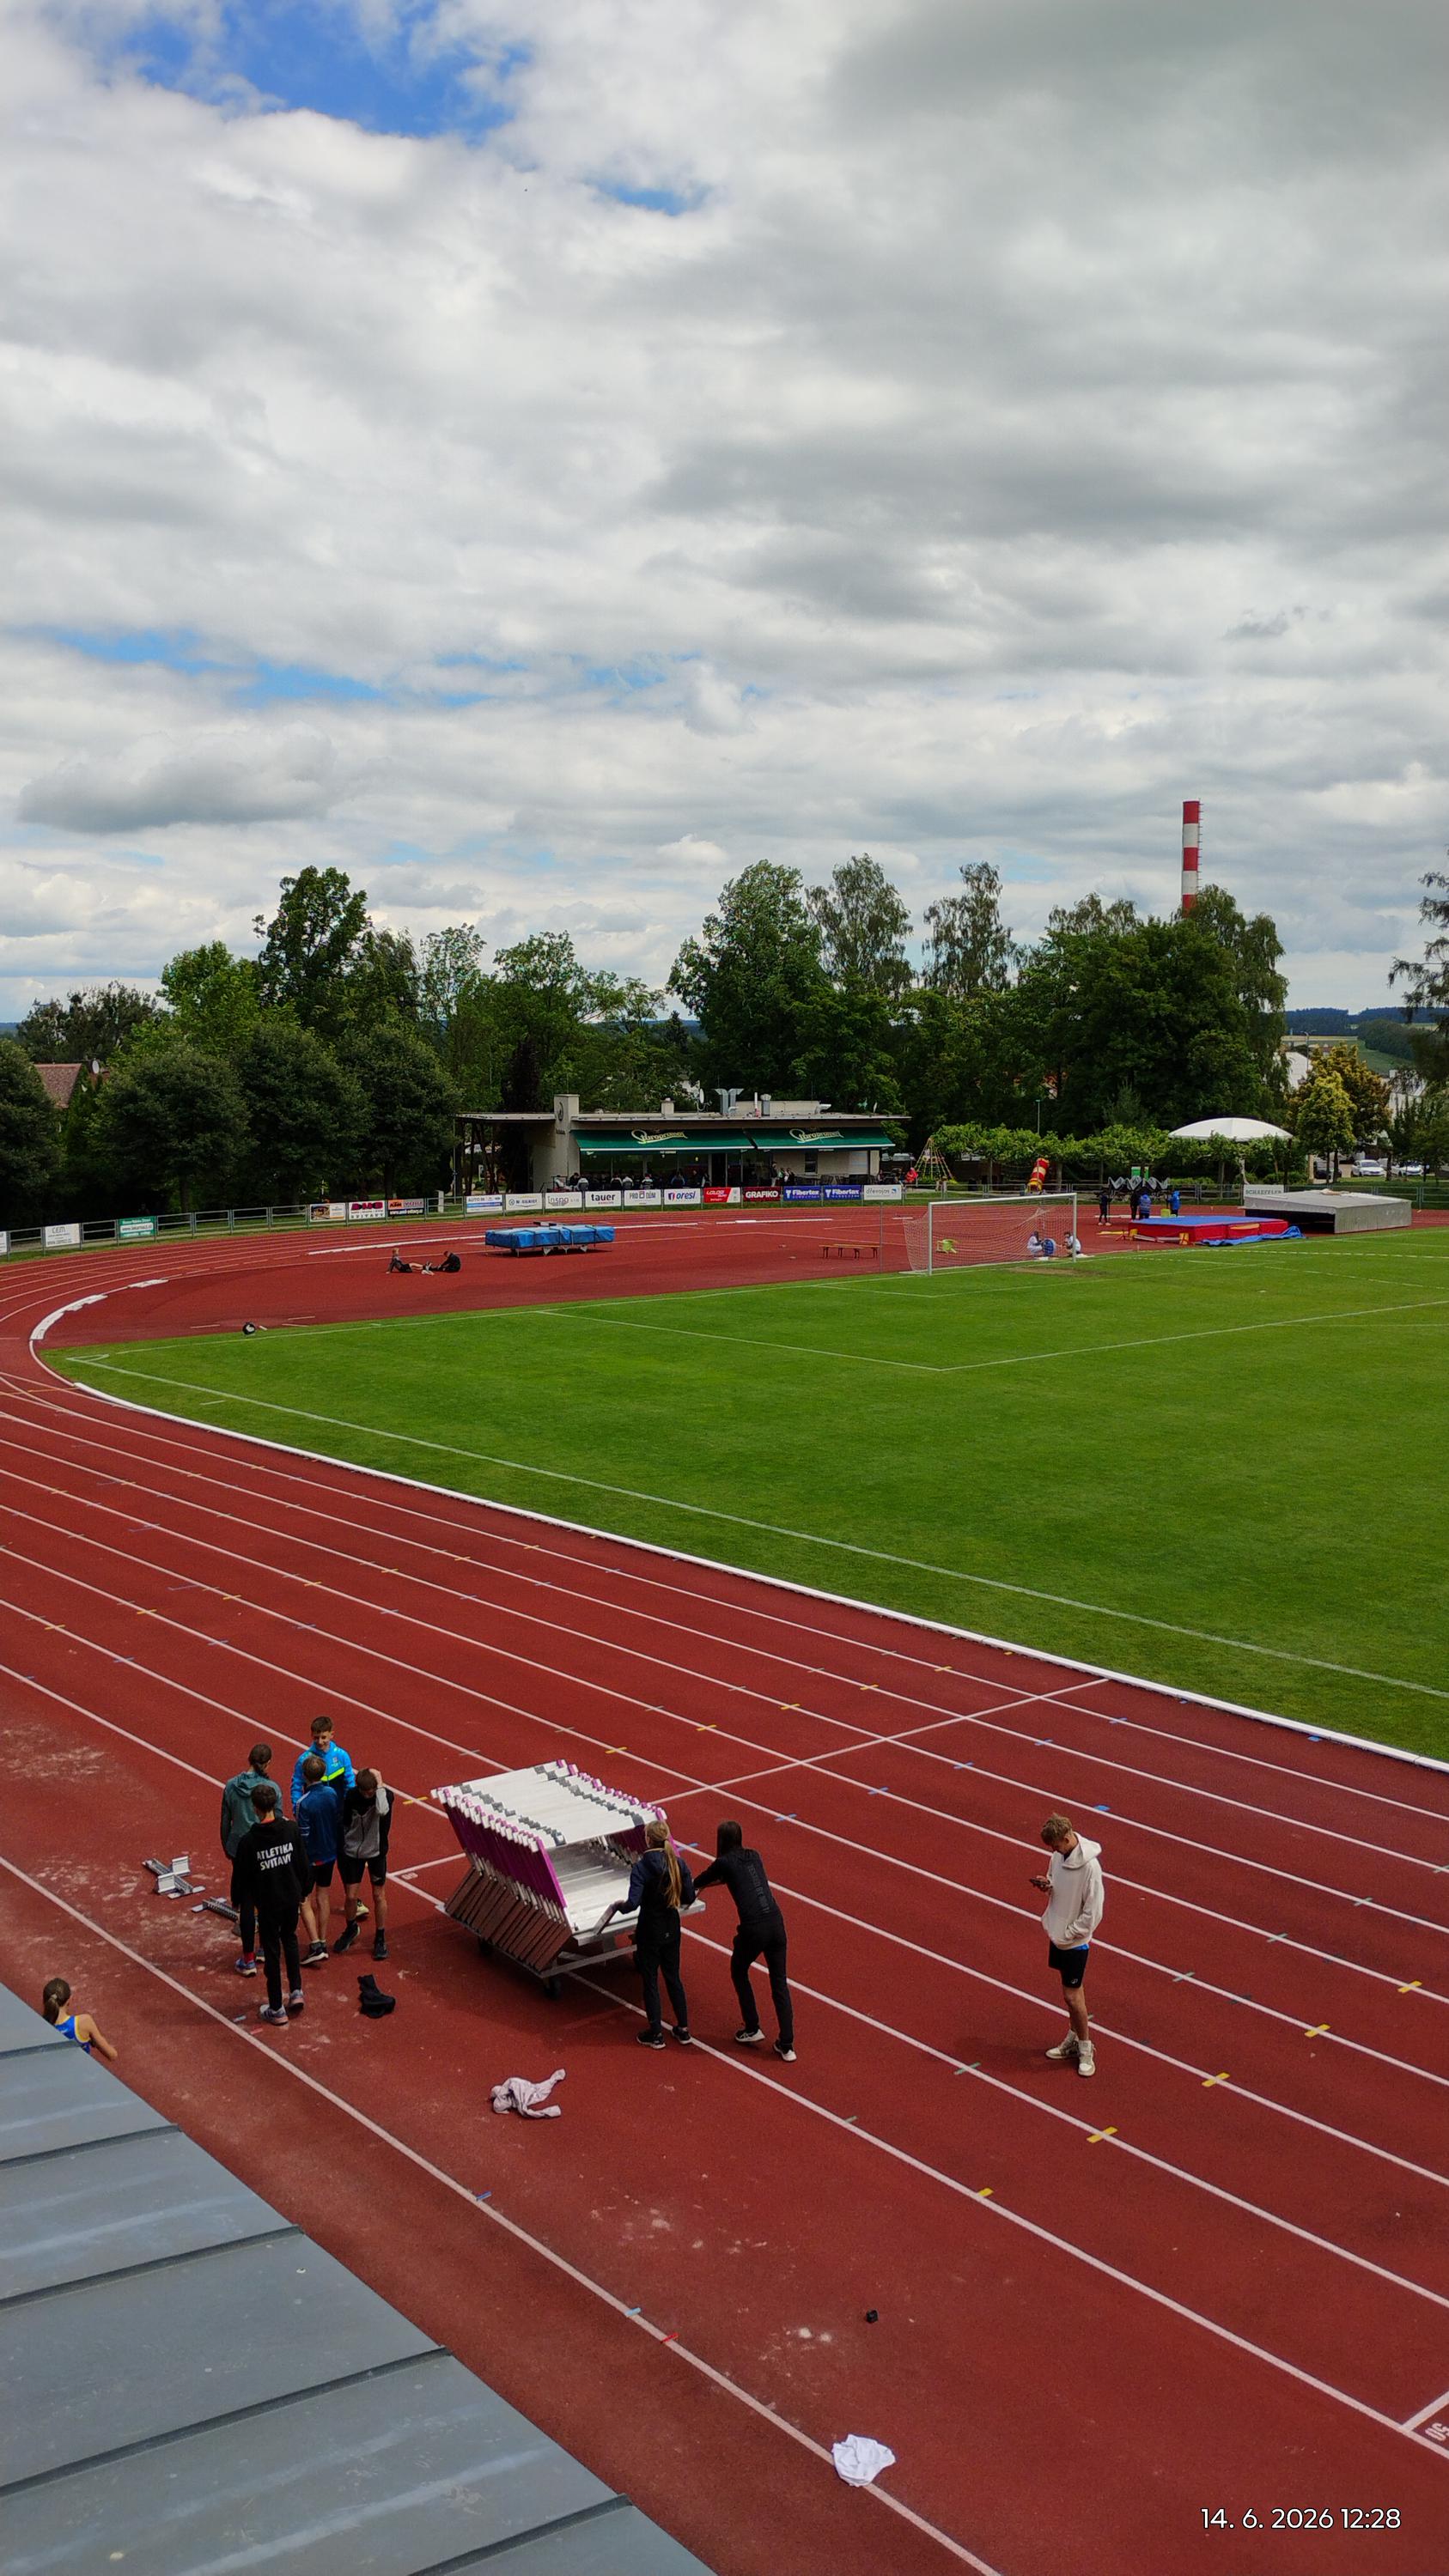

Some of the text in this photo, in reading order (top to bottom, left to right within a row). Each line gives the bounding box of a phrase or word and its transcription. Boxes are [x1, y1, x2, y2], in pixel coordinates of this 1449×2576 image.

[745, 1190, 779, 1199] GRAFIKO
[257, 1842, 294, 1861] ATLETIKA
[259, 1852, 292, 1871] SVITAVY
